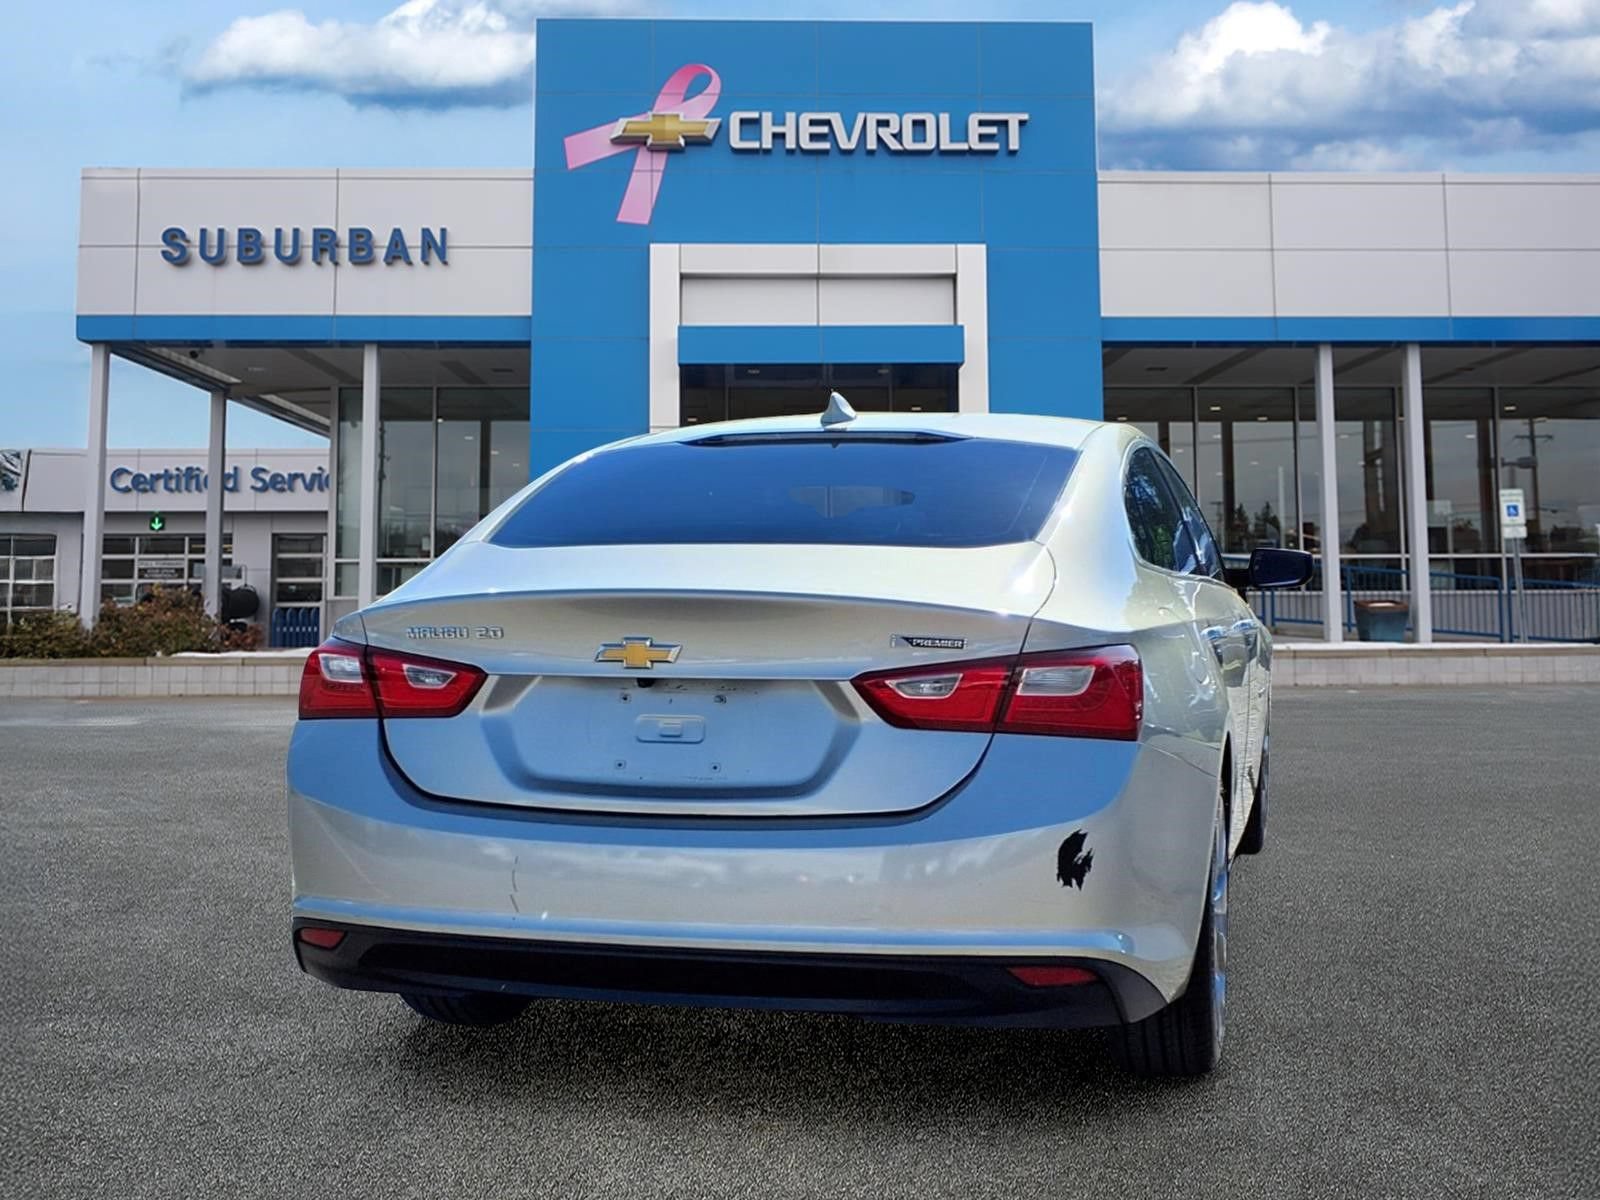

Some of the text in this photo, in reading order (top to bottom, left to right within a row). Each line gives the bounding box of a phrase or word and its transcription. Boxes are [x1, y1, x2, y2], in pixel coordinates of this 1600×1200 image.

[728, 110, 1029, 154] CHEVROLET
[160, 227, 449, 266] SUBURBAN
[912, 638, 963, 648] PREMIER
